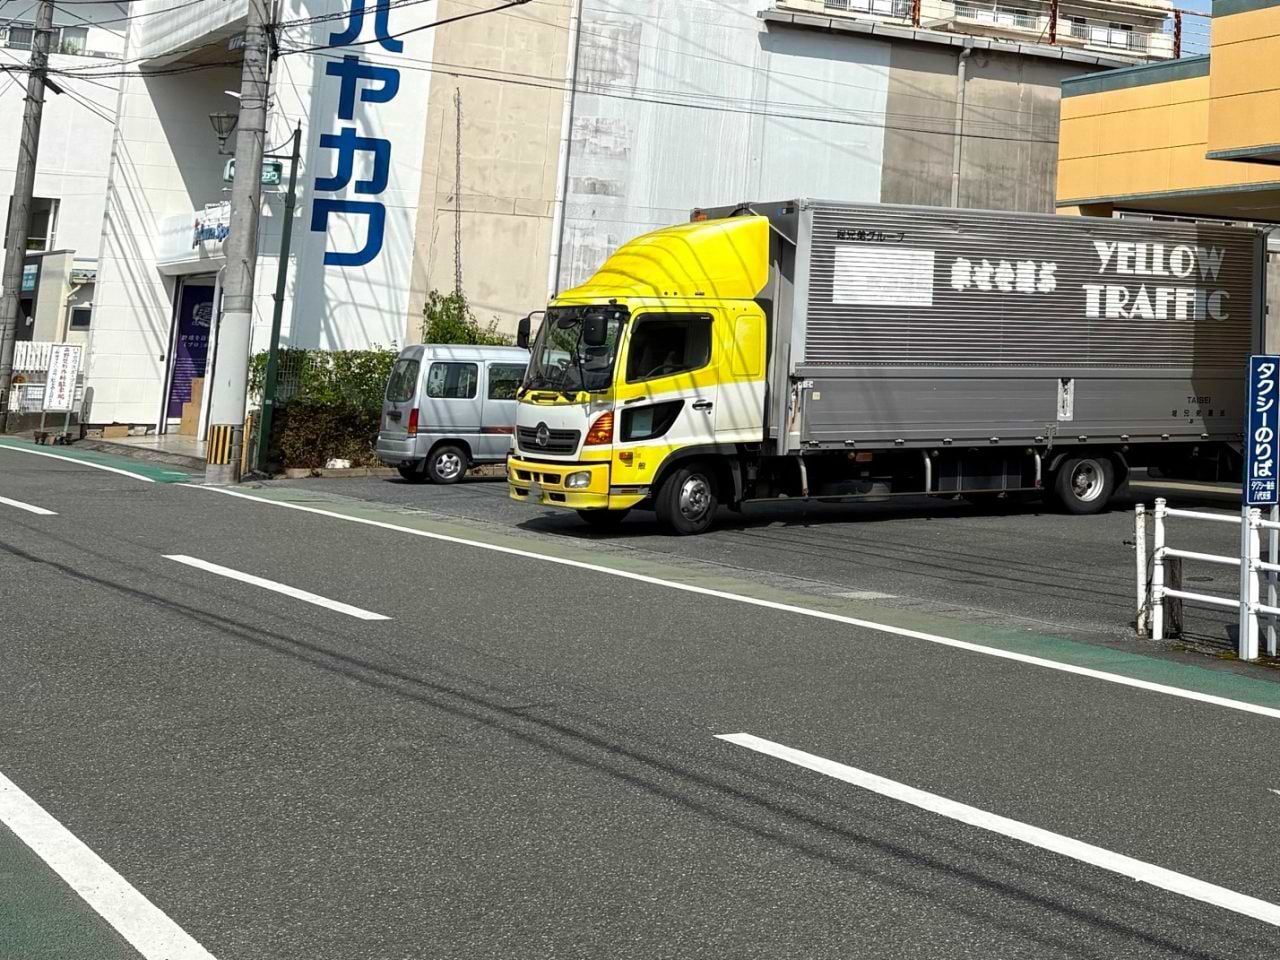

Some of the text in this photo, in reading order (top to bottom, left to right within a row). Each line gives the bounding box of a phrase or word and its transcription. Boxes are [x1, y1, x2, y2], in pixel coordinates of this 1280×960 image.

[1093, 239, 1226, 282] YELLOW
[1082, 283, 1230, 321] TRAFFIC
[1254, 363, 1276, 478] タクシーのりば
